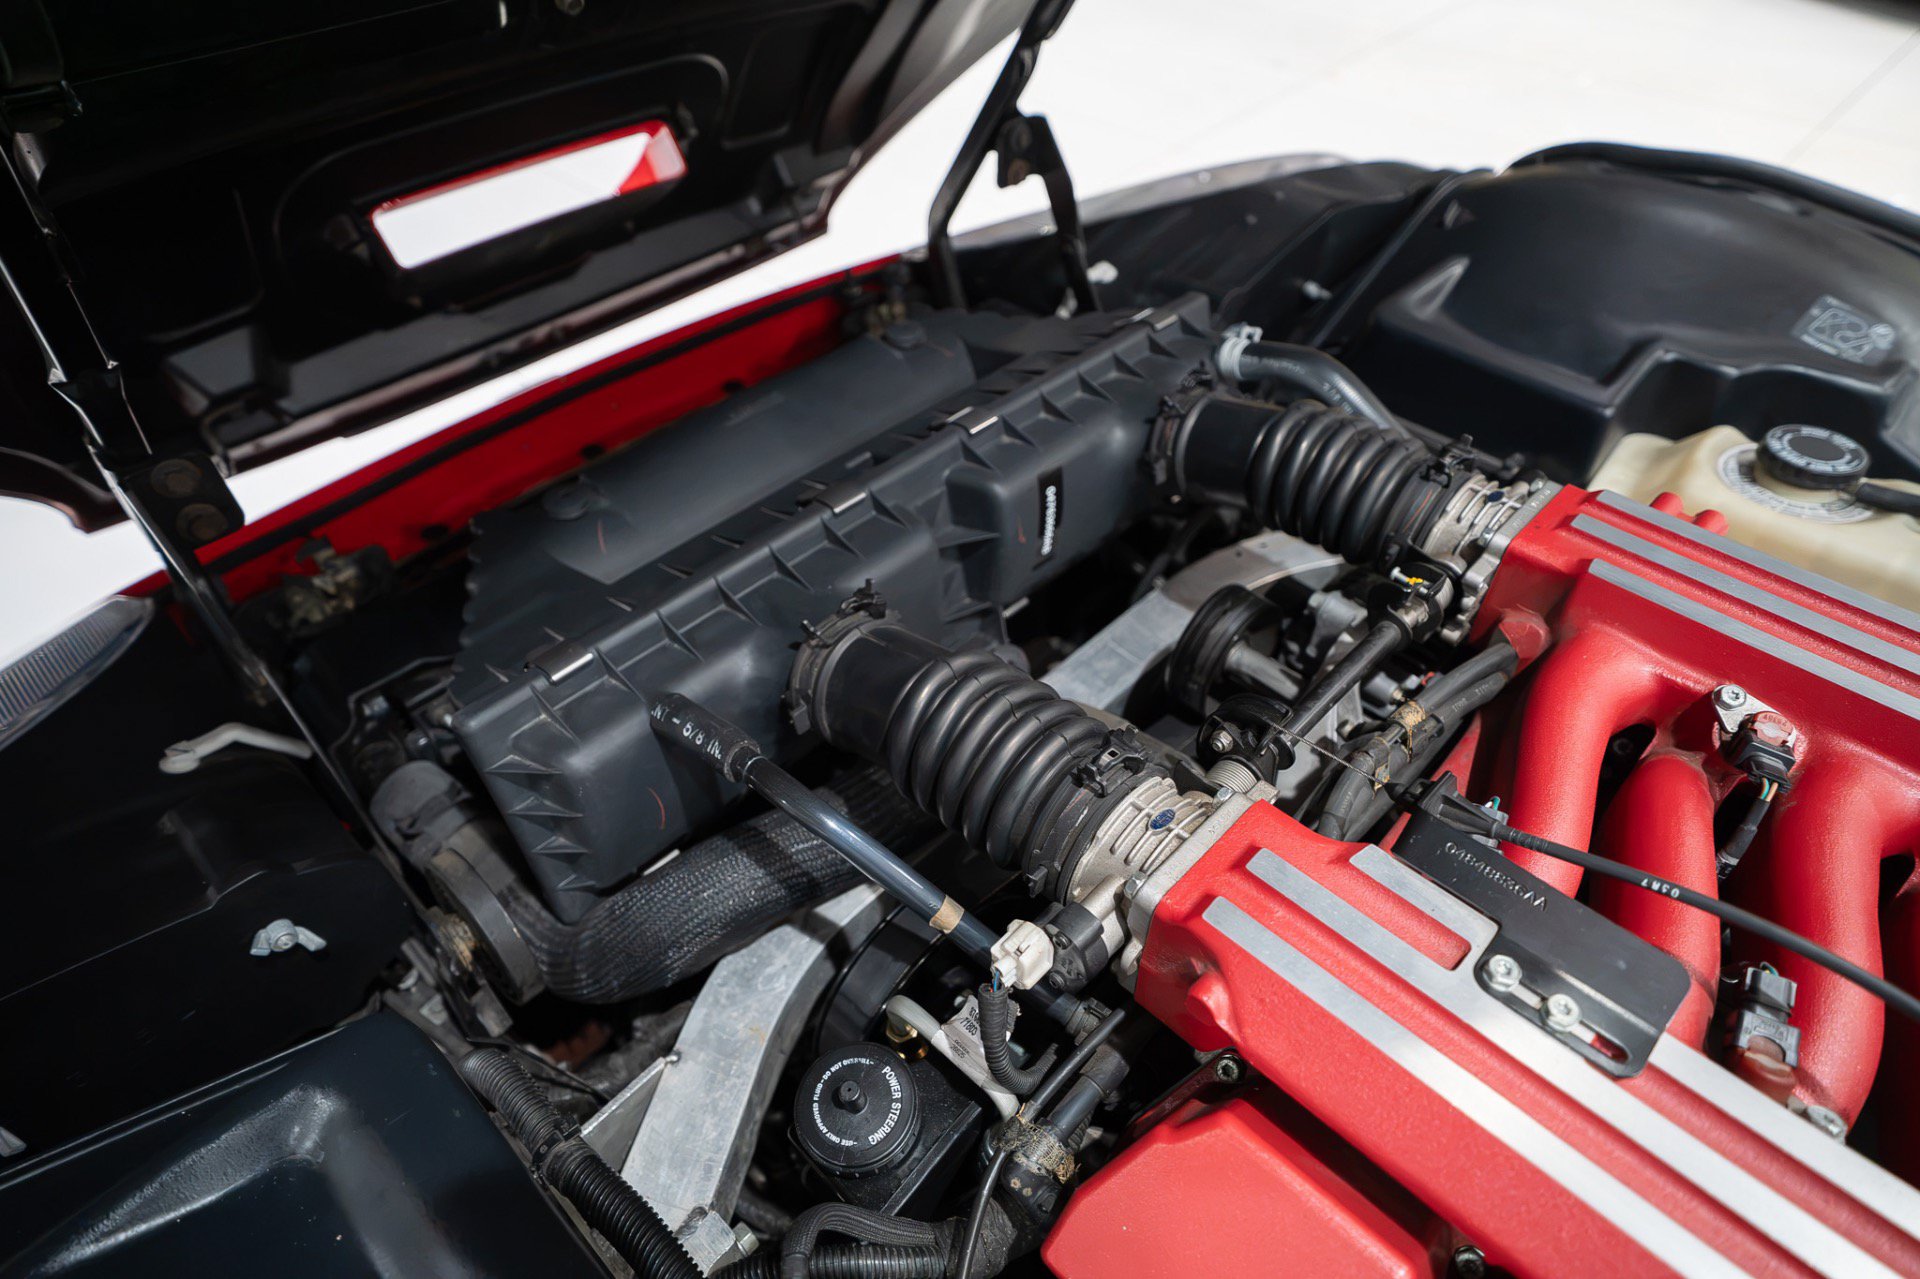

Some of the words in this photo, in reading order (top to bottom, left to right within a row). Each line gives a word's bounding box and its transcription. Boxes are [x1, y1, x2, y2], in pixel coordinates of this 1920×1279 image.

[829, 1061, 842, 1072] NOT
[881, 1065, 902, 1099] POWER
[812, 1102, 828, 1133] APPROVED
[867, 1101, 902, 1145] STEERING
[825, 1131, 840, 1143] ONLY
